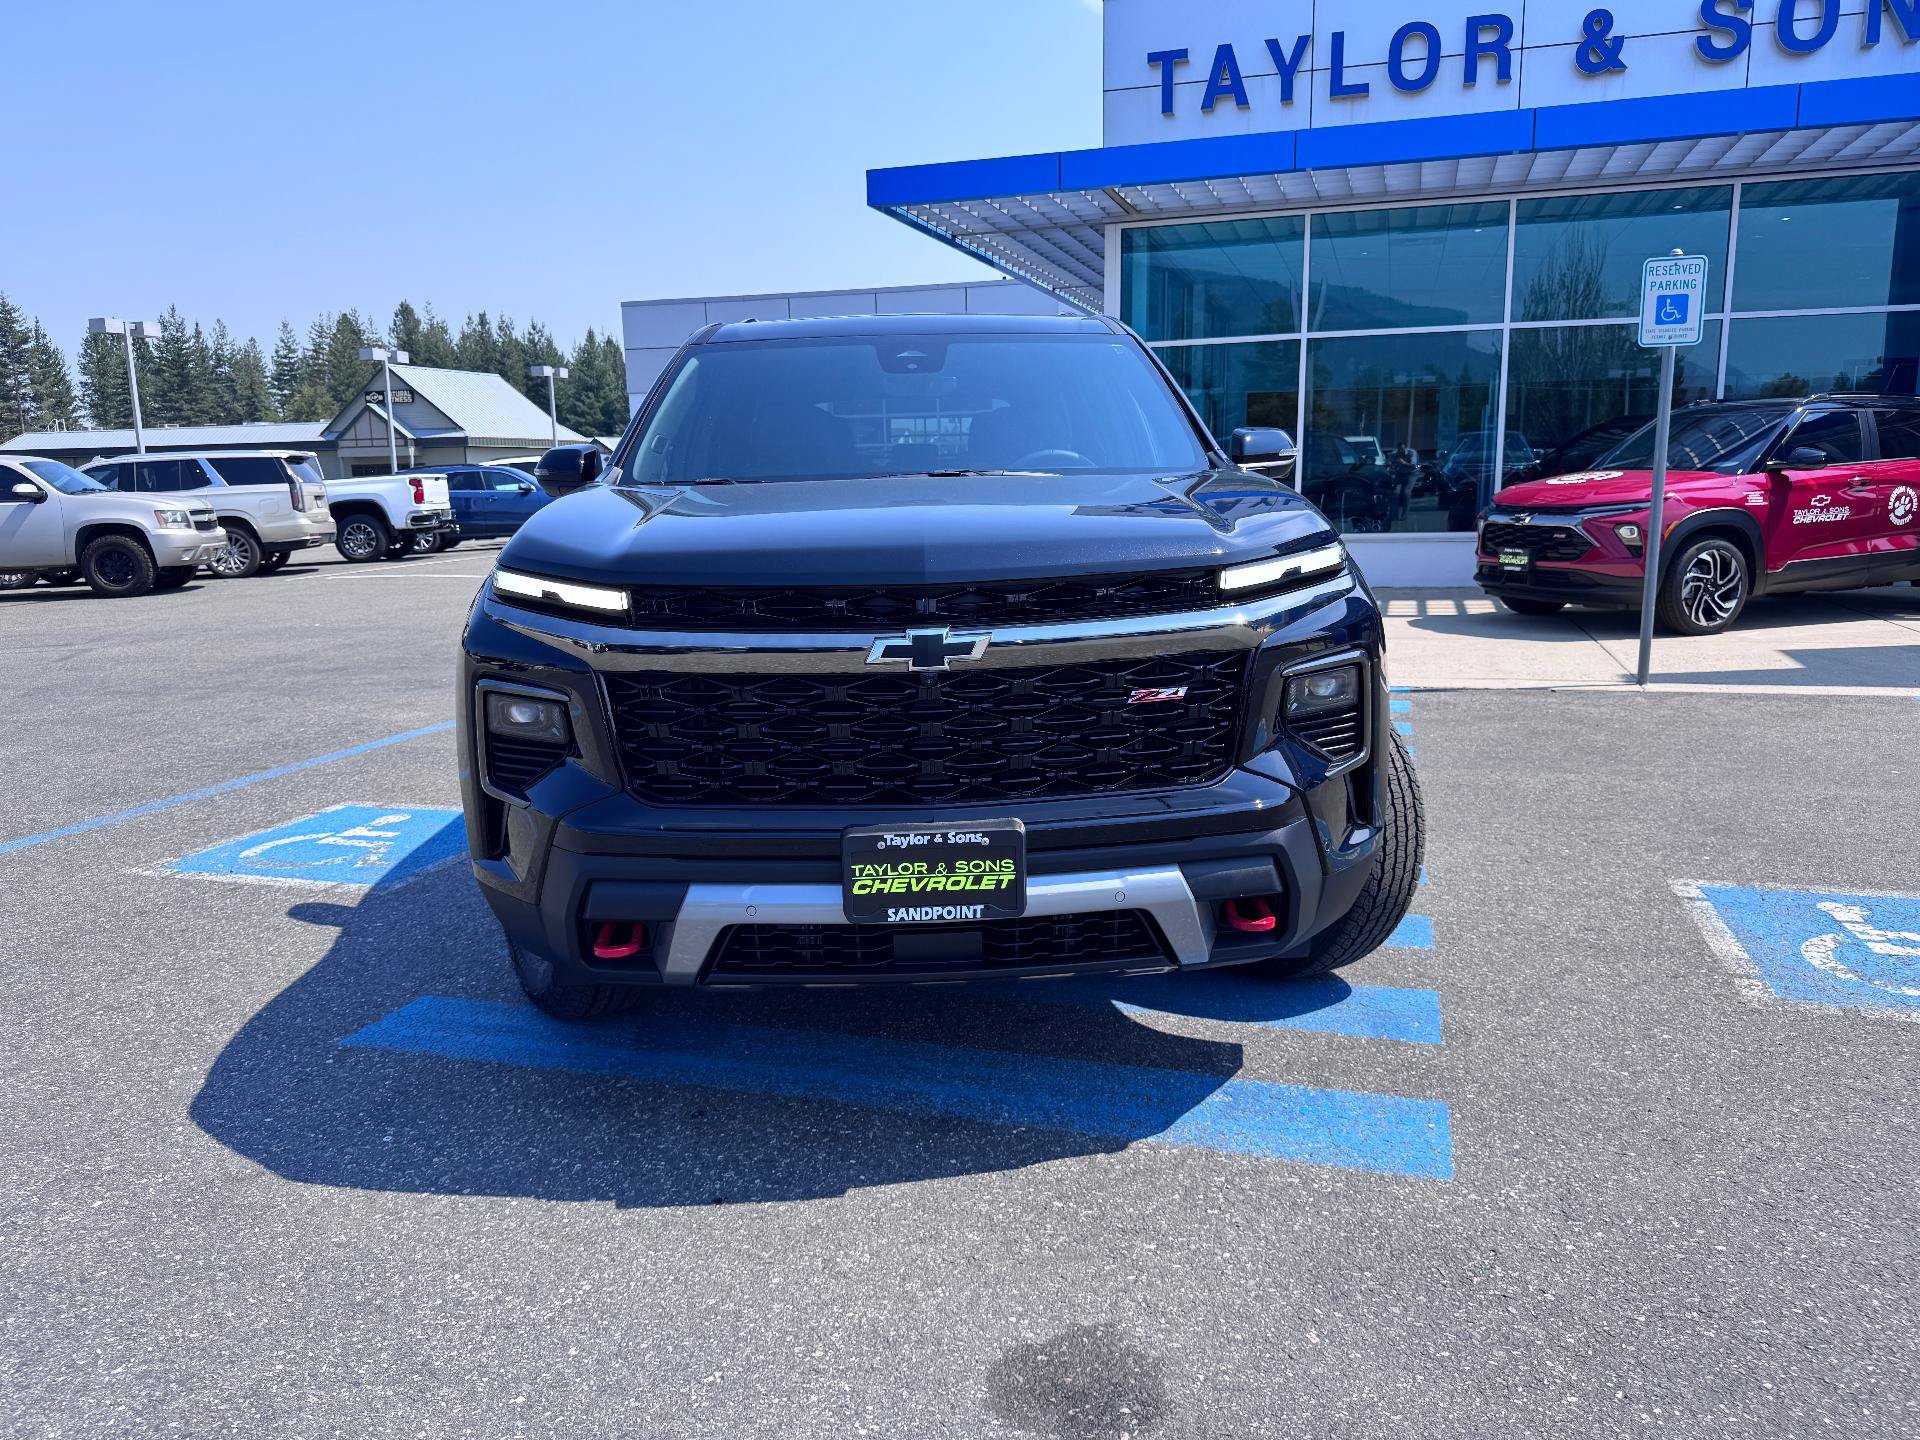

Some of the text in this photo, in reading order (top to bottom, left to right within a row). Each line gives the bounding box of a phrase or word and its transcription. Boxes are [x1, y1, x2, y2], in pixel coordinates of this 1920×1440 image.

[1147, 14, 1515, 116] TAYLOR
[1574, 8, 1627, 77] &
[1648, 264, 1701, 277] RESERVED
[1650, 279, 1697, 291] PARKING
[1792, 513, 1850, 525] CHEVROLET
[1793, 508, 1820, 516] TAYLOR
[1830, 506, 1850, 514] SONS
[1126, 687, 1188, 704] Z71
[884, 832, 982, 849] Taylor & Sons
[851, 859, 1015, 877] TAYLOR & SONS
[852, 875, 1016, 895] CHEVROLET
[887, 904, 985, 922] SANDPOINT
